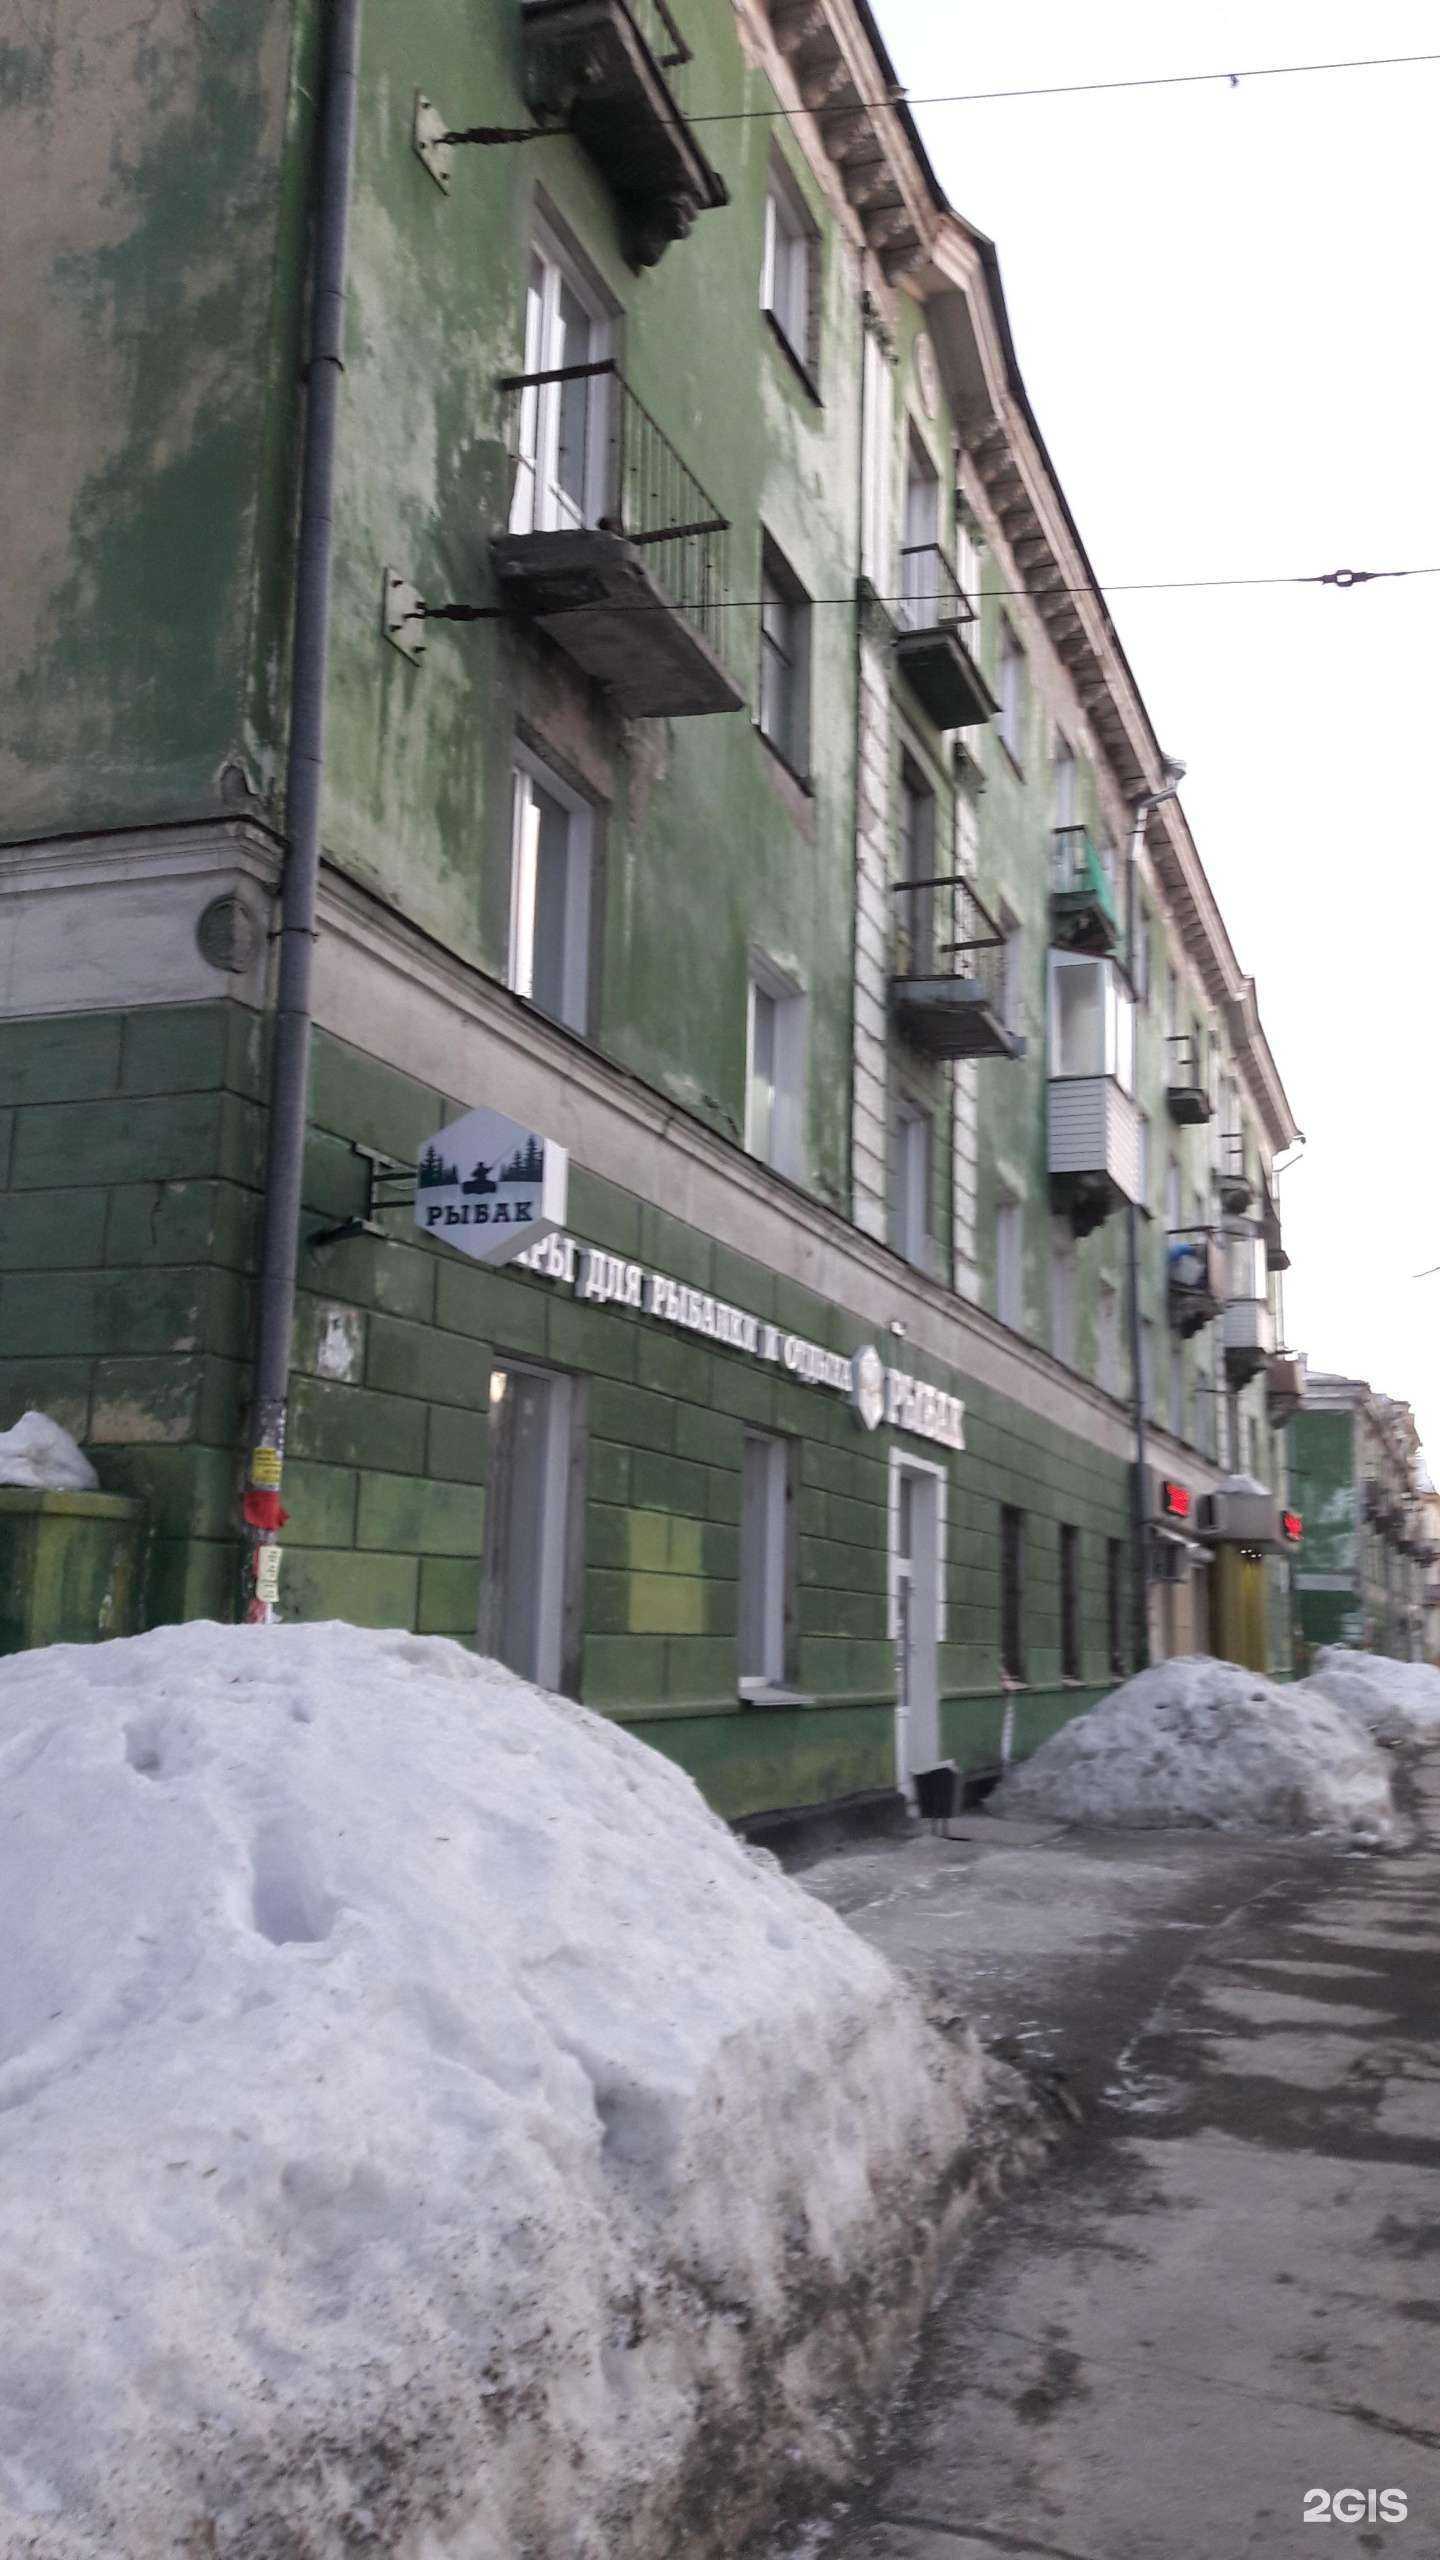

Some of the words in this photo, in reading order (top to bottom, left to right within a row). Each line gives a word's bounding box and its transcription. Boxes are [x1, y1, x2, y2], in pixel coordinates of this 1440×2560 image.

[425, 1201, 533, 1227] РЫБАК
[512, 1232, 576, 1283] РЫ
[583, 1249, 643, 1307] ДЛЯ
[651, 1274, 759, 1354] РЫБАЛКИ
[886, 1367, 966, 1450] РЫБАК
